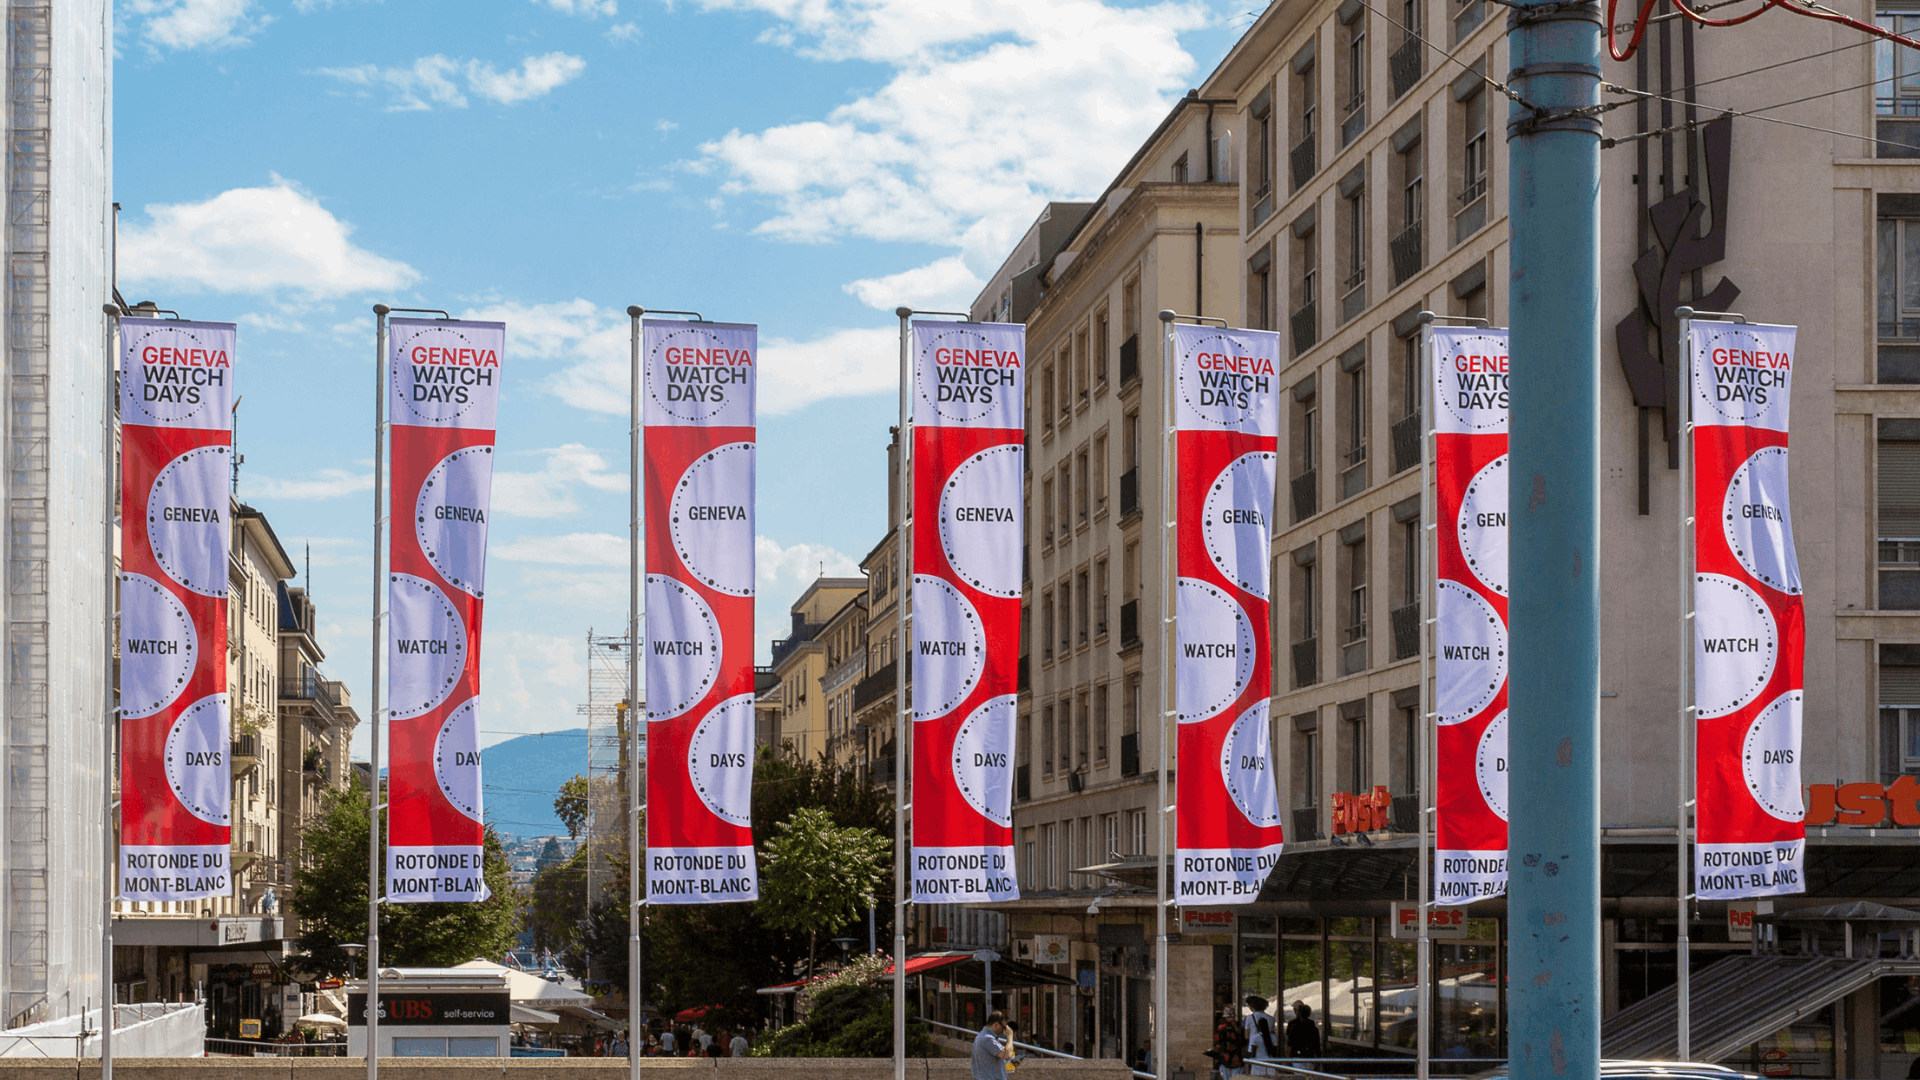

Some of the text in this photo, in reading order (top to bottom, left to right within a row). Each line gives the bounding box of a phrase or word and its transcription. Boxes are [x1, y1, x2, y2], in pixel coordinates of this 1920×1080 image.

[142, 346, 230, 368] GENEVA
[411, 346, 499, 368] GENEVA
[665, 347, 753, 367] GENEVA
[935, 347, 1021, 368] GENEVA
[1197, 352, 1275, 376] GENEVA
[1455, 354, 1508, 373] GENE
[1712, 348, 1790, 371] GENEVA
[142, 364, 224, 387] WATCH
[411, 365, 492, 386] WATCH
[666, 365, 747, 385] WATCH
[936, 366, 1015, 387] WATCH
[1198, 370, 1269, 394] WATCH
[1456, 372, 1508, 392] WAT
[1713, 366, 1785, 389] WATCH
[143, 383, 201, 405] DAYS
[413, 383, 469, 404] DAYS
[667, 383, 724, 403] DAYS
[937, 384, 993, 404] DAYS
[1200, 388, 1249, 410] DAYS
[1458, 391, 1508, 410] DAYS
[1716, 384, 1767, 405] DAYS
[163, 506, 220, 524] GENEVA
[434, 505, 485, 524] GENEVA
[688, 505, 747, 521] GENEVA
[955, 507, 1014, 522] GENEVA
[1476, 512, 1506, 528] GEN
[1741, 503, 1783, 523] GENEVA
[127, 638, 178, 655] WATCH
[397, 639, 448, 655] WATCH
[653, 640, 703, 656] WATCH
[919, 640, 966, 657] WATCH
[1184, 643, 1236, 658] WATCH
[1443, 645, 1490, 661] WATCH
[1703, 638, 1759, 653] WATCH
[185, 751, 222, 767] DAYS
[455, 751, 481, 766] DAY
[710, 753, 746, 768] DAYS
[974, 752, 1007, 768] DAYS
[1763, 749, 1794, 765] DAYS
[1801, 775, 1920, 826] ust
[127, 853, 223, 869] ROTONDE DU
[395, 853, 469, 870] ROTONDE
[653, 854, 747, 871] ROTONDE DU
[918, 854, 989, 871] ROTONDE
[1184, 853, 1277, 873] ROTONDE DU
[1443, 858, 1505, 874] ROTONDE
[1703, 847, 1797, 867] ROTONDE DU
[124, 875, 225, 893] MONT-BLANC
[392, 877, 481, 894] MONT-BLAN
[651, 877, 751, 895] MONT-BLANC
[915, 877, 1012, 895] MONT-BLANC
[1180, 879, 1265, 896] MONT-BLA
[1440, 880, 1508, 897] MONT-BLA
[1700, 868, 1798, 891] MONT-BLANC
[1185, 911, 1234, 924] Fust
[390, 1000, 495, 1019] UBS self-service
